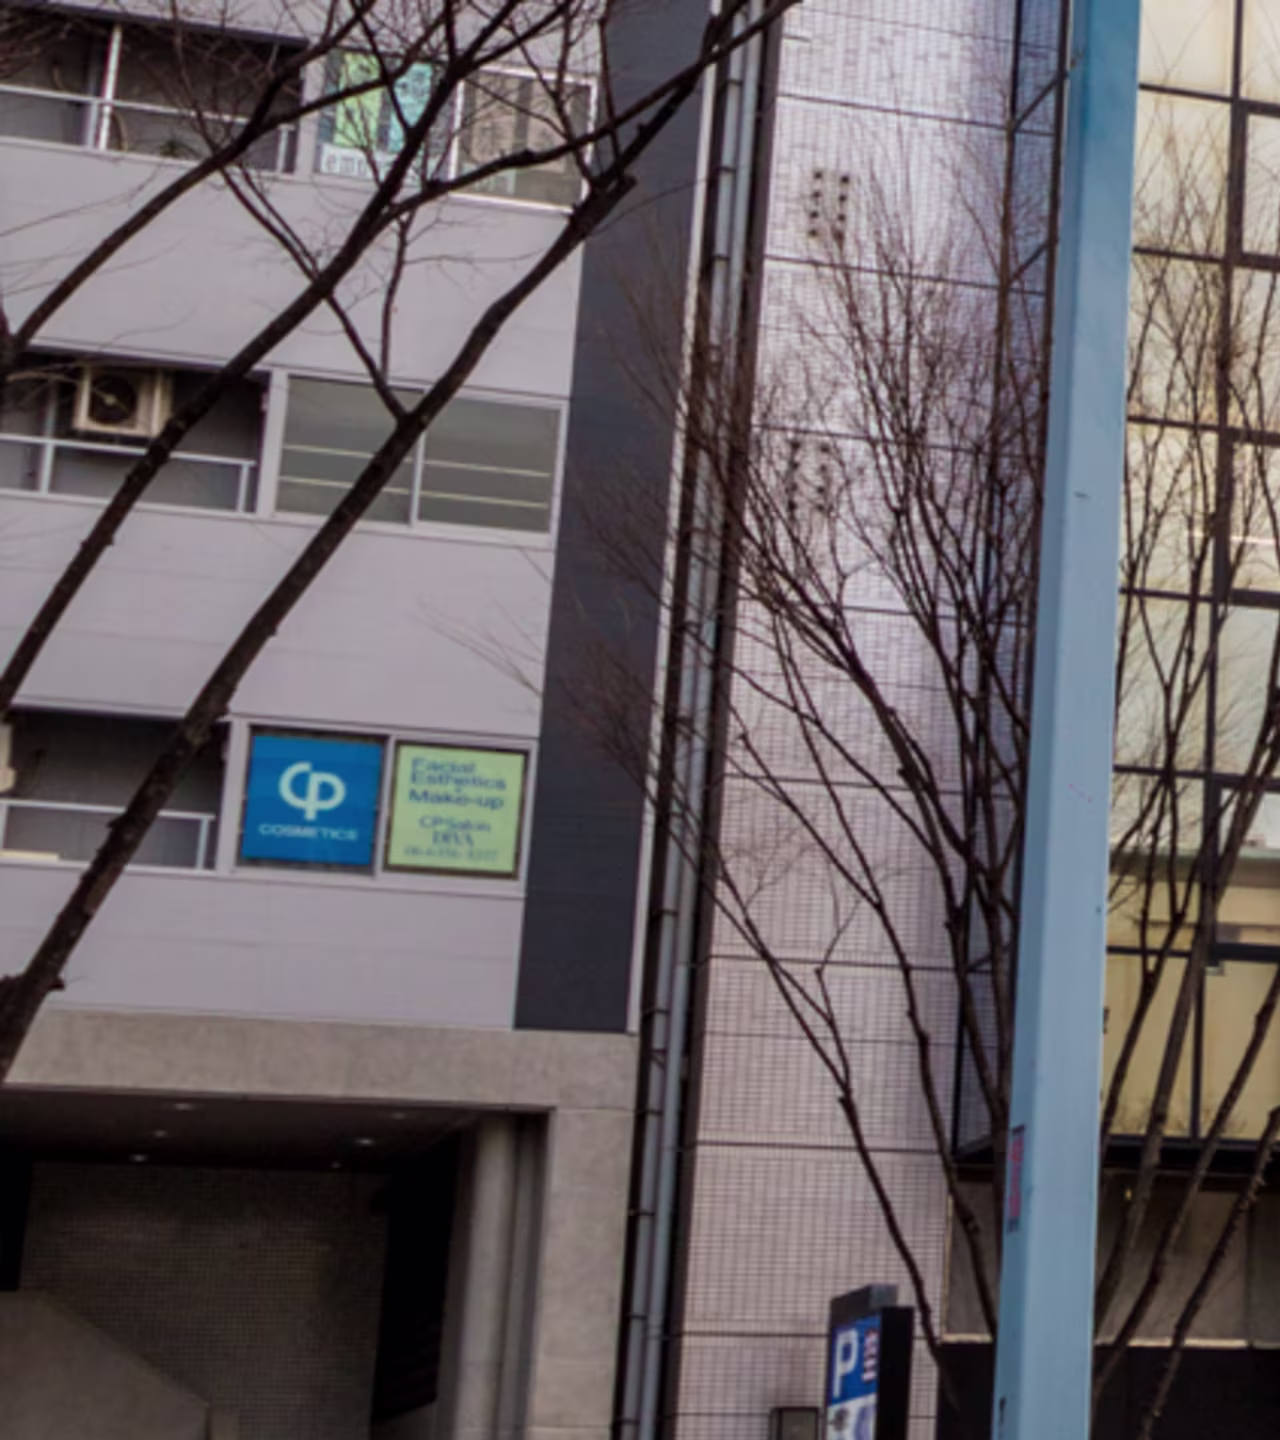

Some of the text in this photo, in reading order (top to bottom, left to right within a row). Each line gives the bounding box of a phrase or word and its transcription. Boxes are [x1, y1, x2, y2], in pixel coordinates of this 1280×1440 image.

[408, 789, 505, 810] Make-up
[258, 823, 359, 841] COSMETICS
[832, 1328, 858, 1399] P
